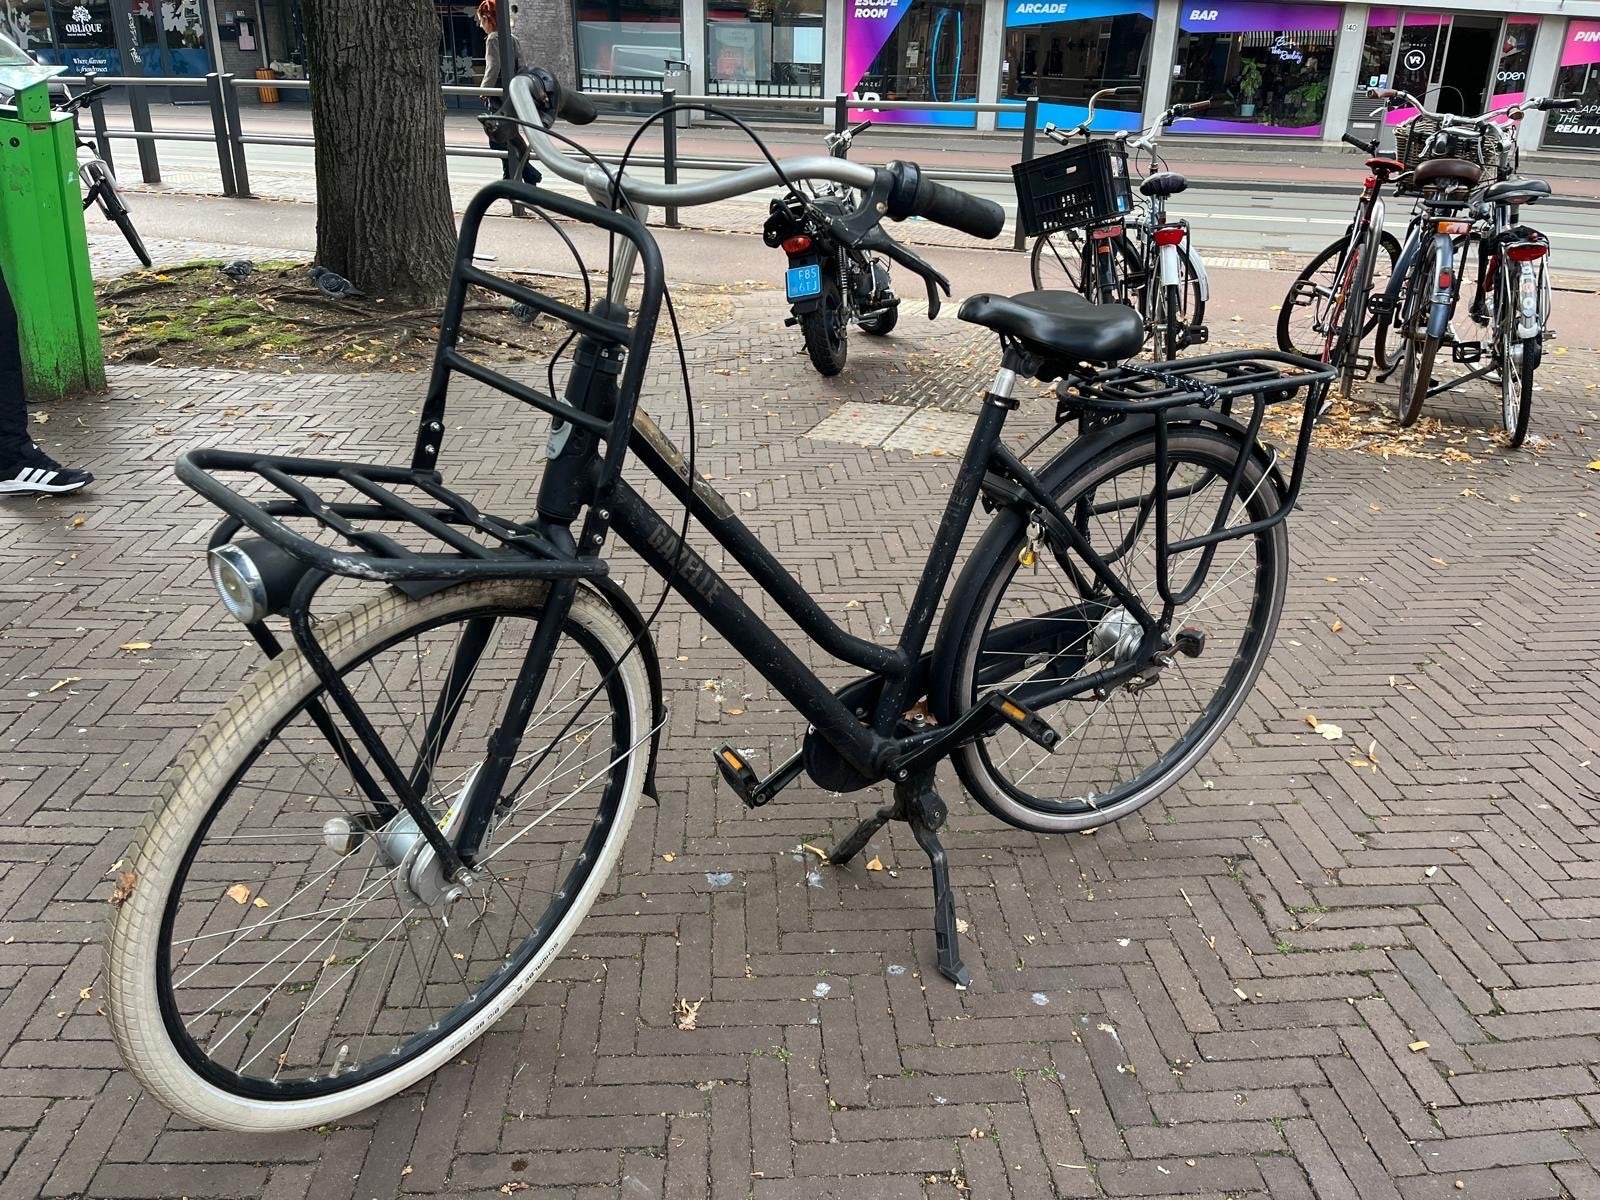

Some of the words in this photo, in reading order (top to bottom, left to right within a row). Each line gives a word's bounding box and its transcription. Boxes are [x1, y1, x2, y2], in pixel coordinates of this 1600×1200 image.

[854, 8, 889, 18] ROOM
[1016, 3, 1068, 14] ARCADE
[1190, 10, 1218, 20] BAR
[65, 23, 103, 36] OBLIQUE
[1409, 55, 1422, 65] VR
[1497, 71, 1526, 82] open
[1559, 114, 1581, 123] THE
